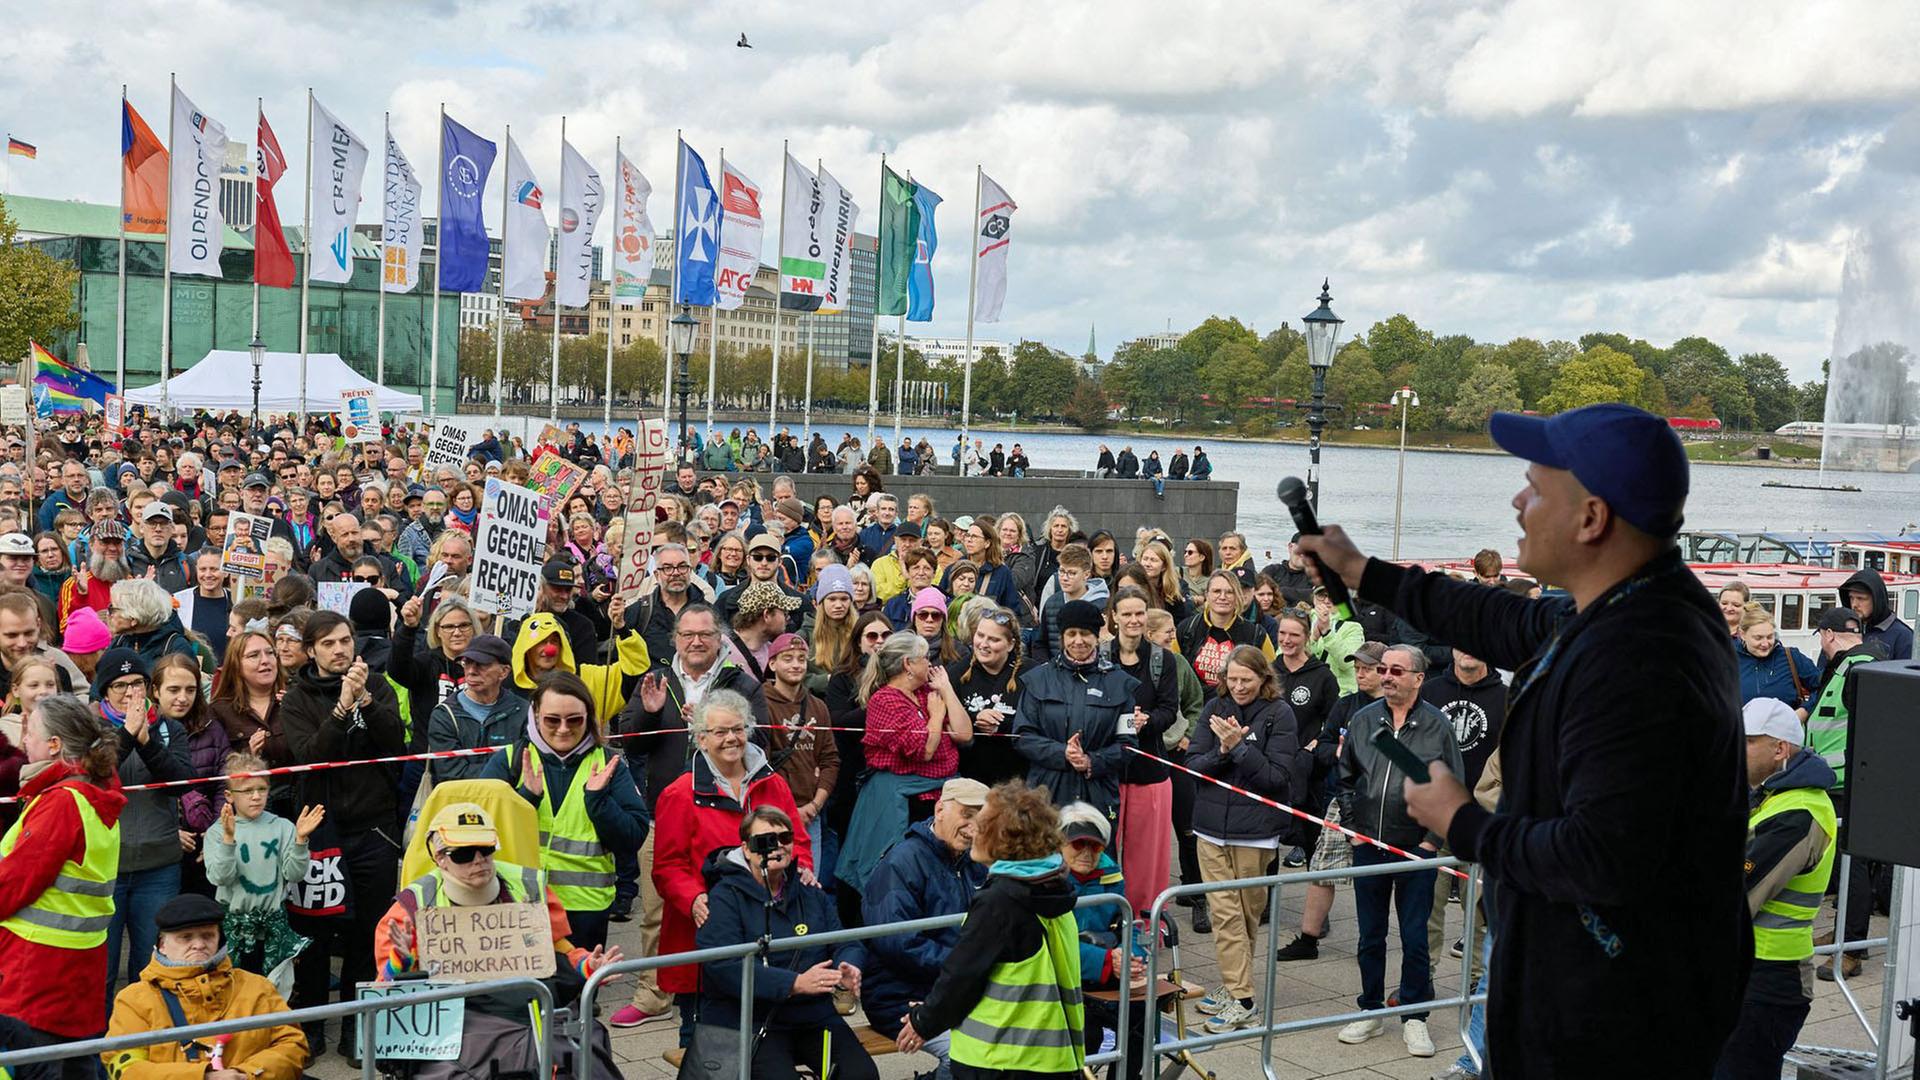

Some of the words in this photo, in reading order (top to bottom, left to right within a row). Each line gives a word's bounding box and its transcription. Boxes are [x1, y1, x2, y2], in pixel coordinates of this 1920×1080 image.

[718, 268, 751, 292] ATG
[441, 425, 467, 443] OMAS
[428, 451, 463, 468] RECHTS
[435, 438, 466, 457] GEGEN
[497, 490, 539, 529] OMAS
[487, 524, 540, 565] GEGEN
[622, 530, 653, 592] Bee
[476, 558, 537, 602] RECHTS
[284, 881, 346, 910] AFD
[425, 914, 458, 935] ICH
[470, 910, 531, 932] ROLLE
[426, 936, 467, 955] FÜR
[479, 934, 513, 952] DIE
[427, 954, 544, 977] DEMOKRATIE
